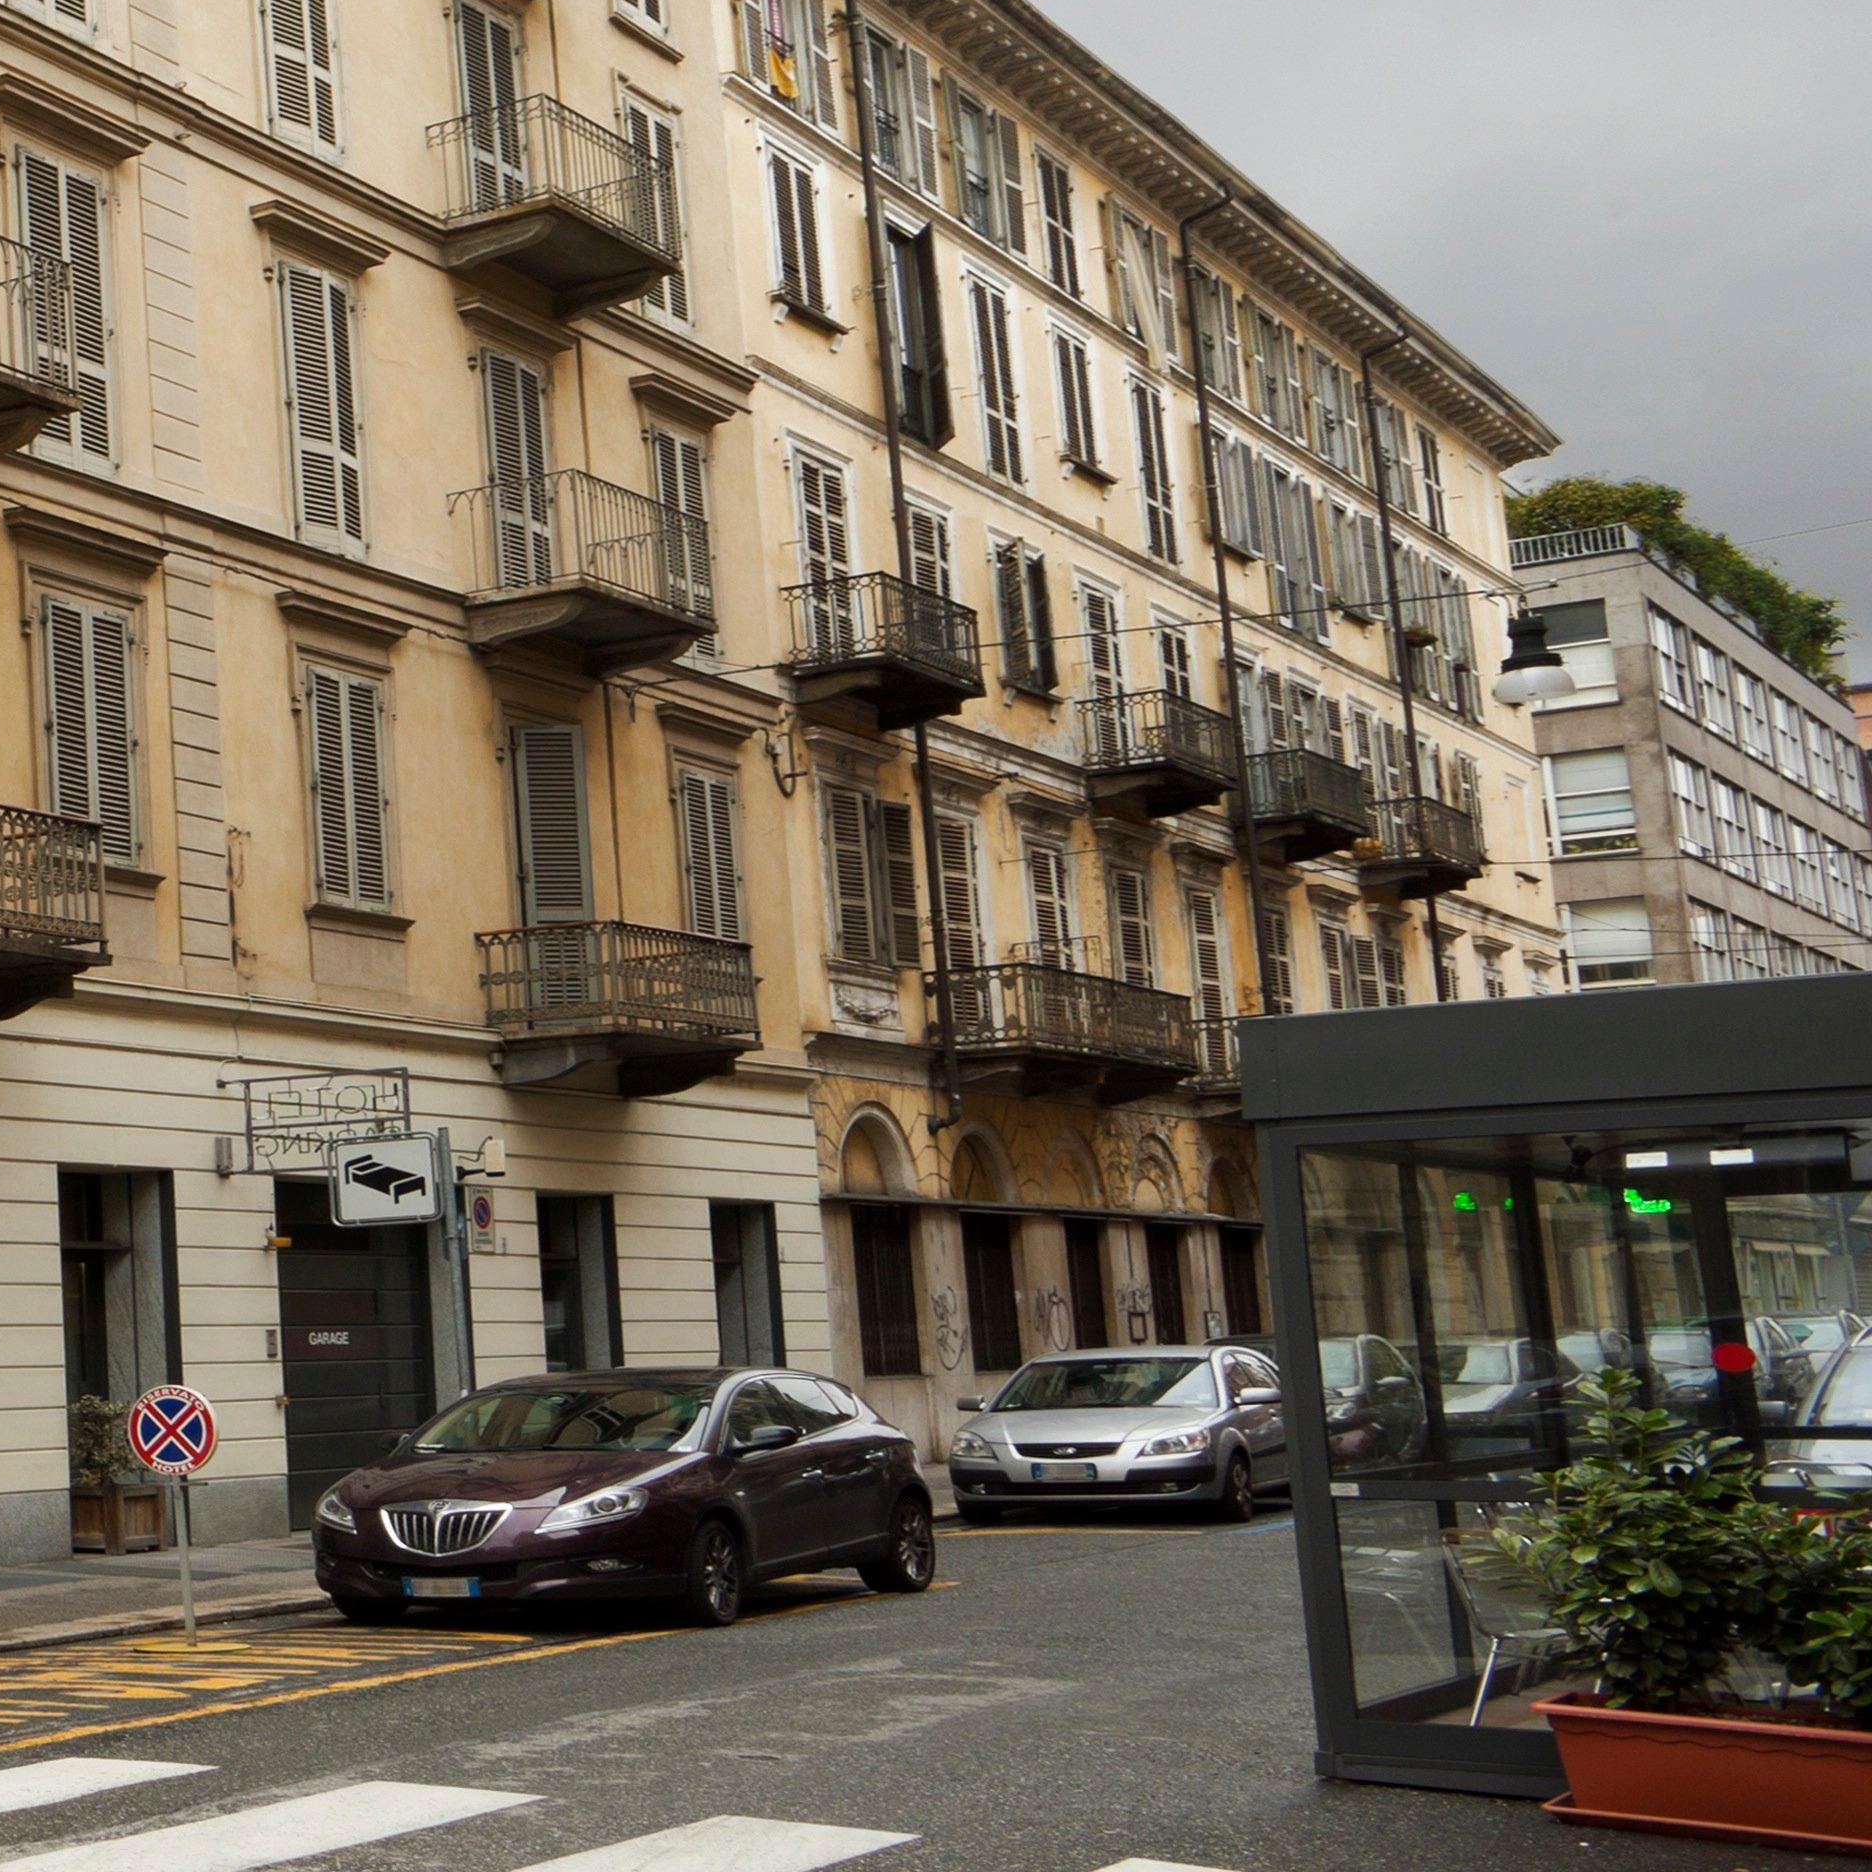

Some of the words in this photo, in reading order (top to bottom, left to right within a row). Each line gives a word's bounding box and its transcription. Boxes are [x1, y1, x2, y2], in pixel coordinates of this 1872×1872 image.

[308, 1331, 350, 1345] GARAGE
[137, 1388, 205, 1412] RISERVATO
[151, 1461, 196, 1474] HOTEL
